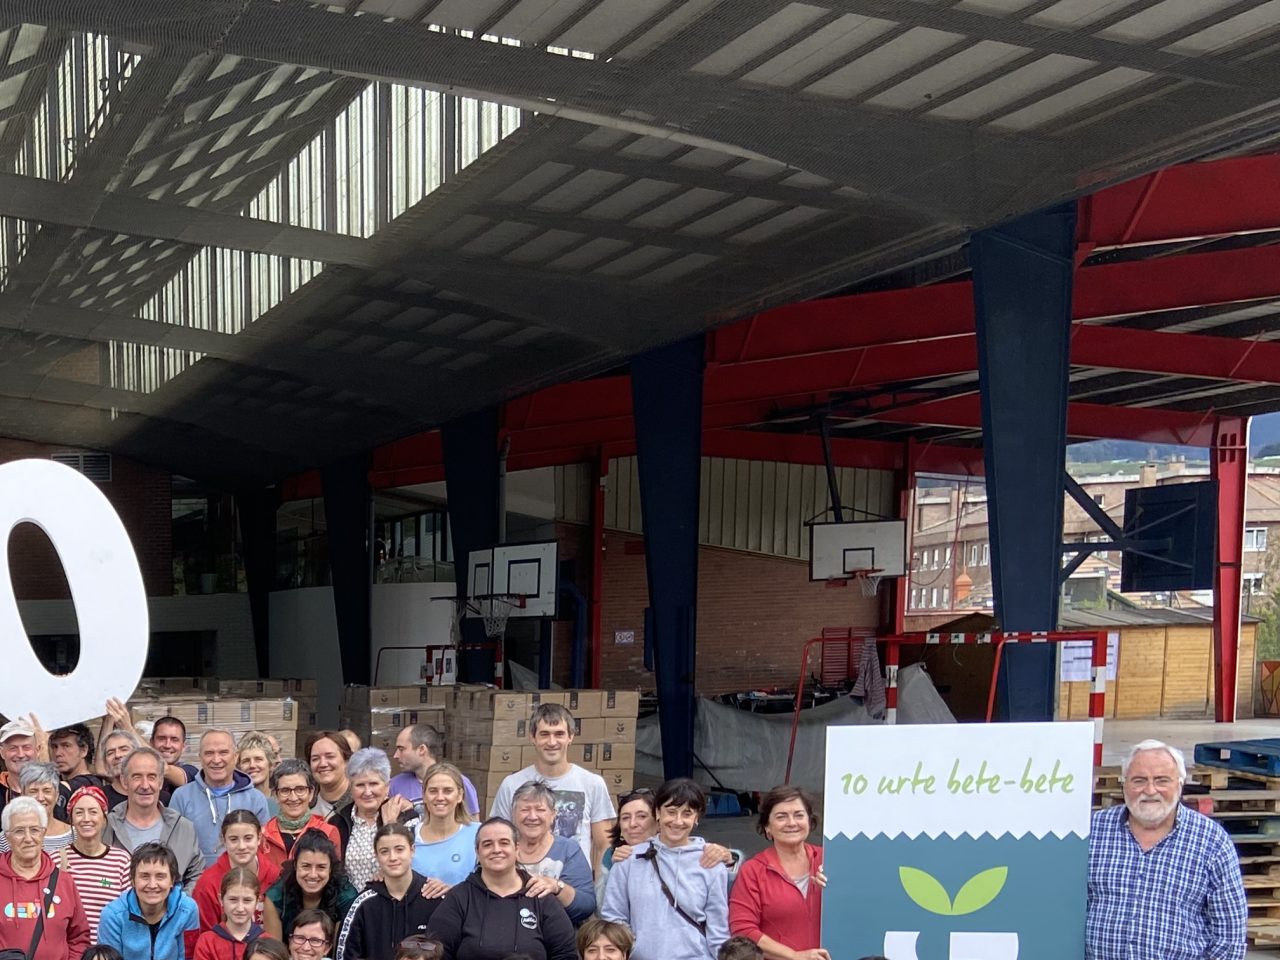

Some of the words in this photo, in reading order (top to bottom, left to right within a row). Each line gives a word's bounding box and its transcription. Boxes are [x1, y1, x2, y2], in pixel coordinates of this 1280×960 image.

[841, 772, 868, 795] 10
[877, 760, 936, 795] urte
[947, 757, 1075, 794] bete-bete
